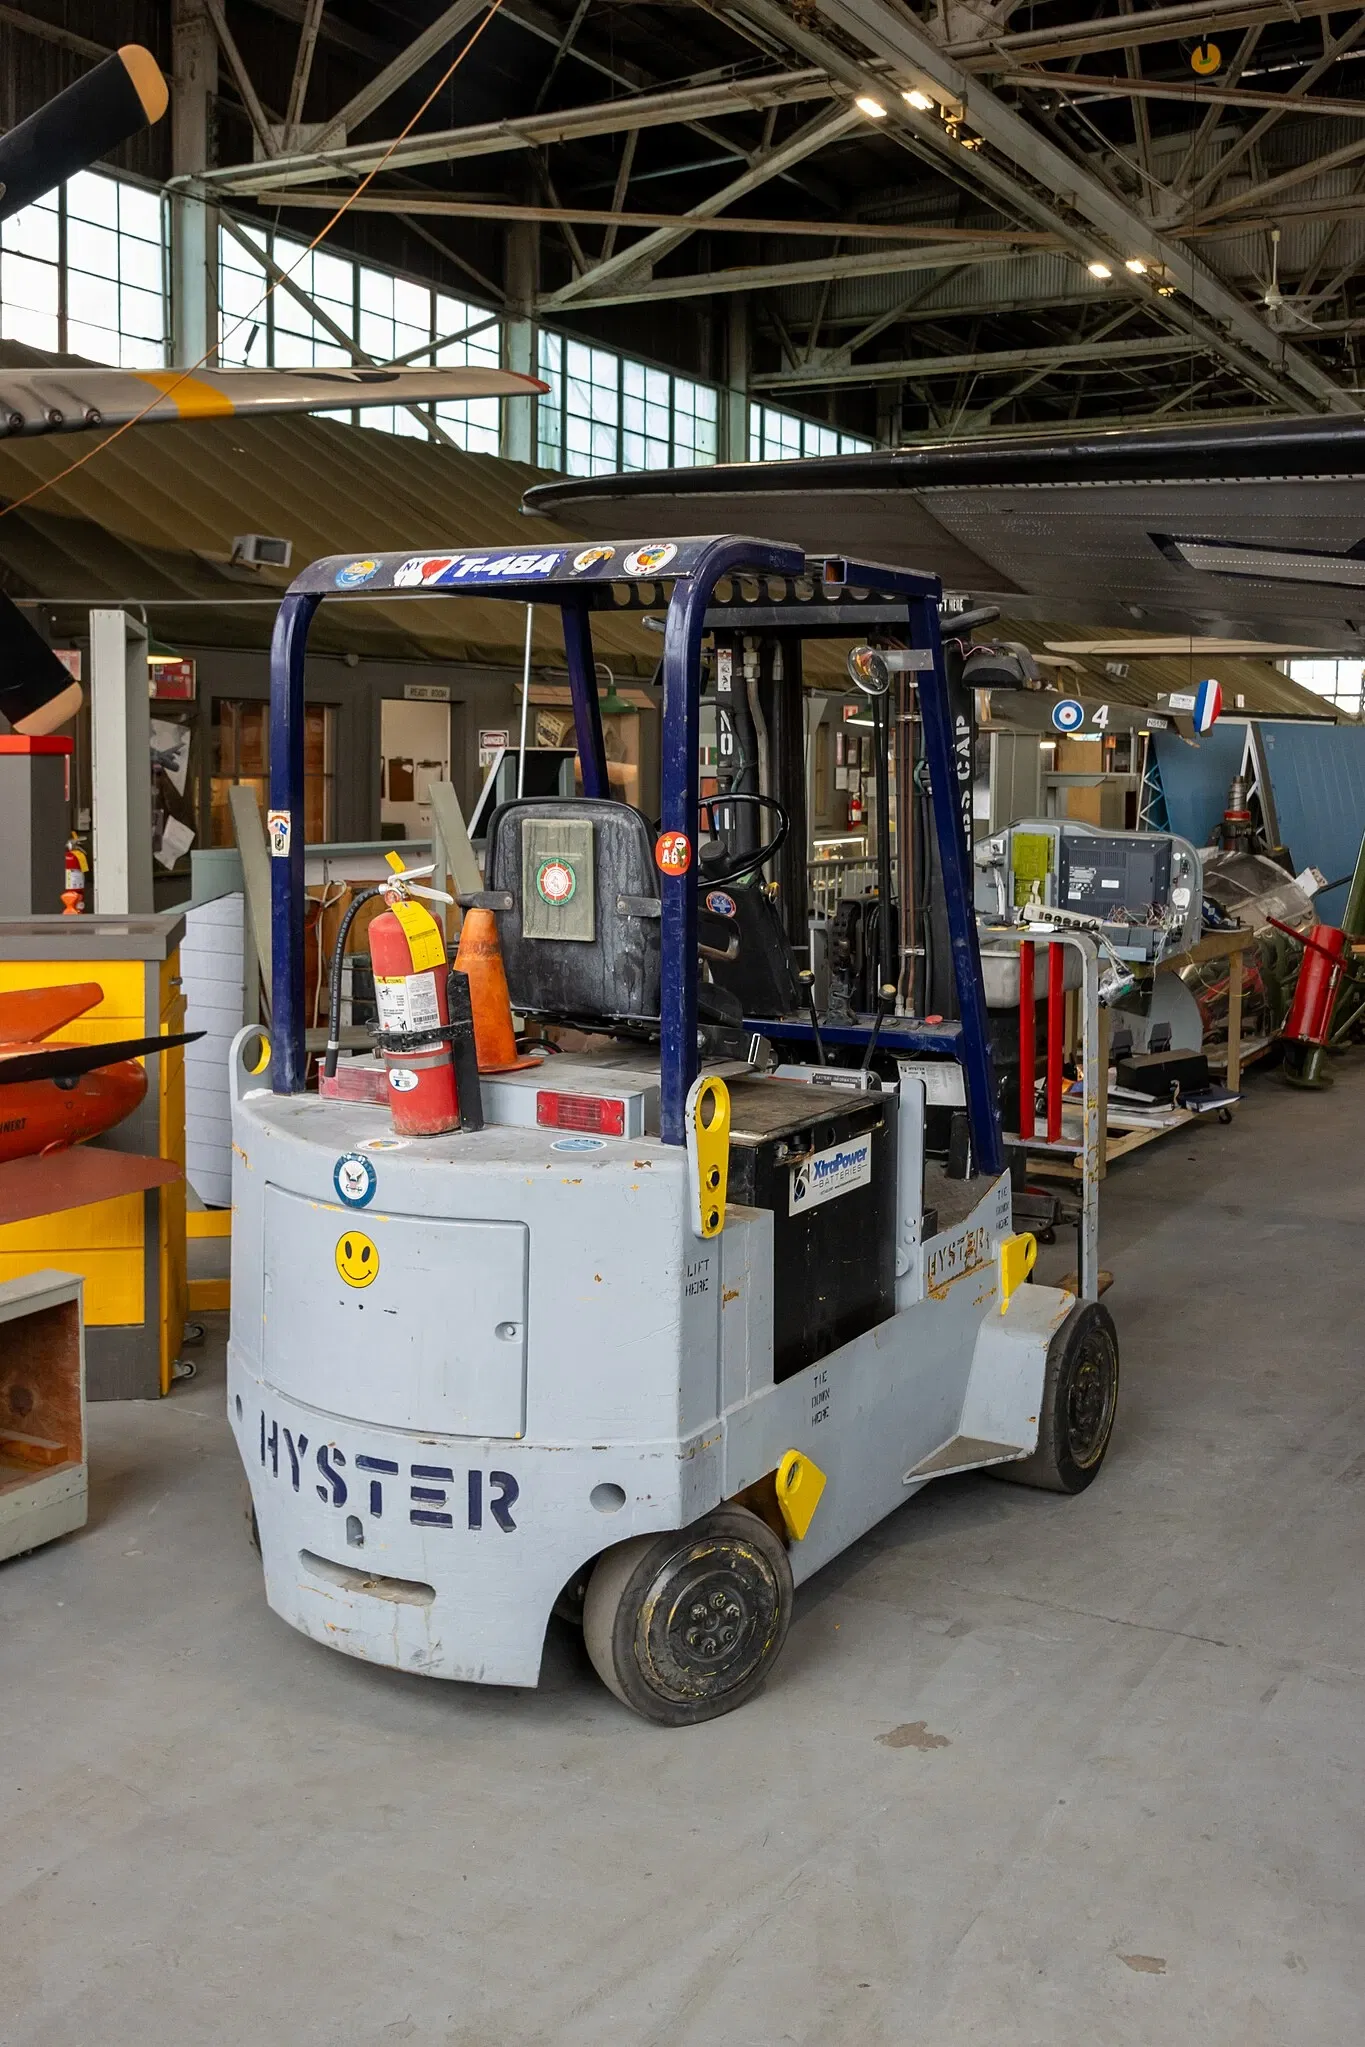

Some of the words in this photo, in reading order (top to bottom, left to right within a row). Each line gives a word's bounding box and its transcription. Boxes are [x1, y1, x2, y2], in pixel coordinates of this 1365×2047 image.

[453, 554, 560, 577] T-46A
[1091, 704, 1109, 729] 4
[813, 1147, 868, 1181] XtraPower
[819, 1163, 862, 1189] BATTERIES
[687, 1258, 710, 1278] LIFT
[685, 1278, 709, 1297] HERE
[260, 1410, 520, 1533] HYSTER
